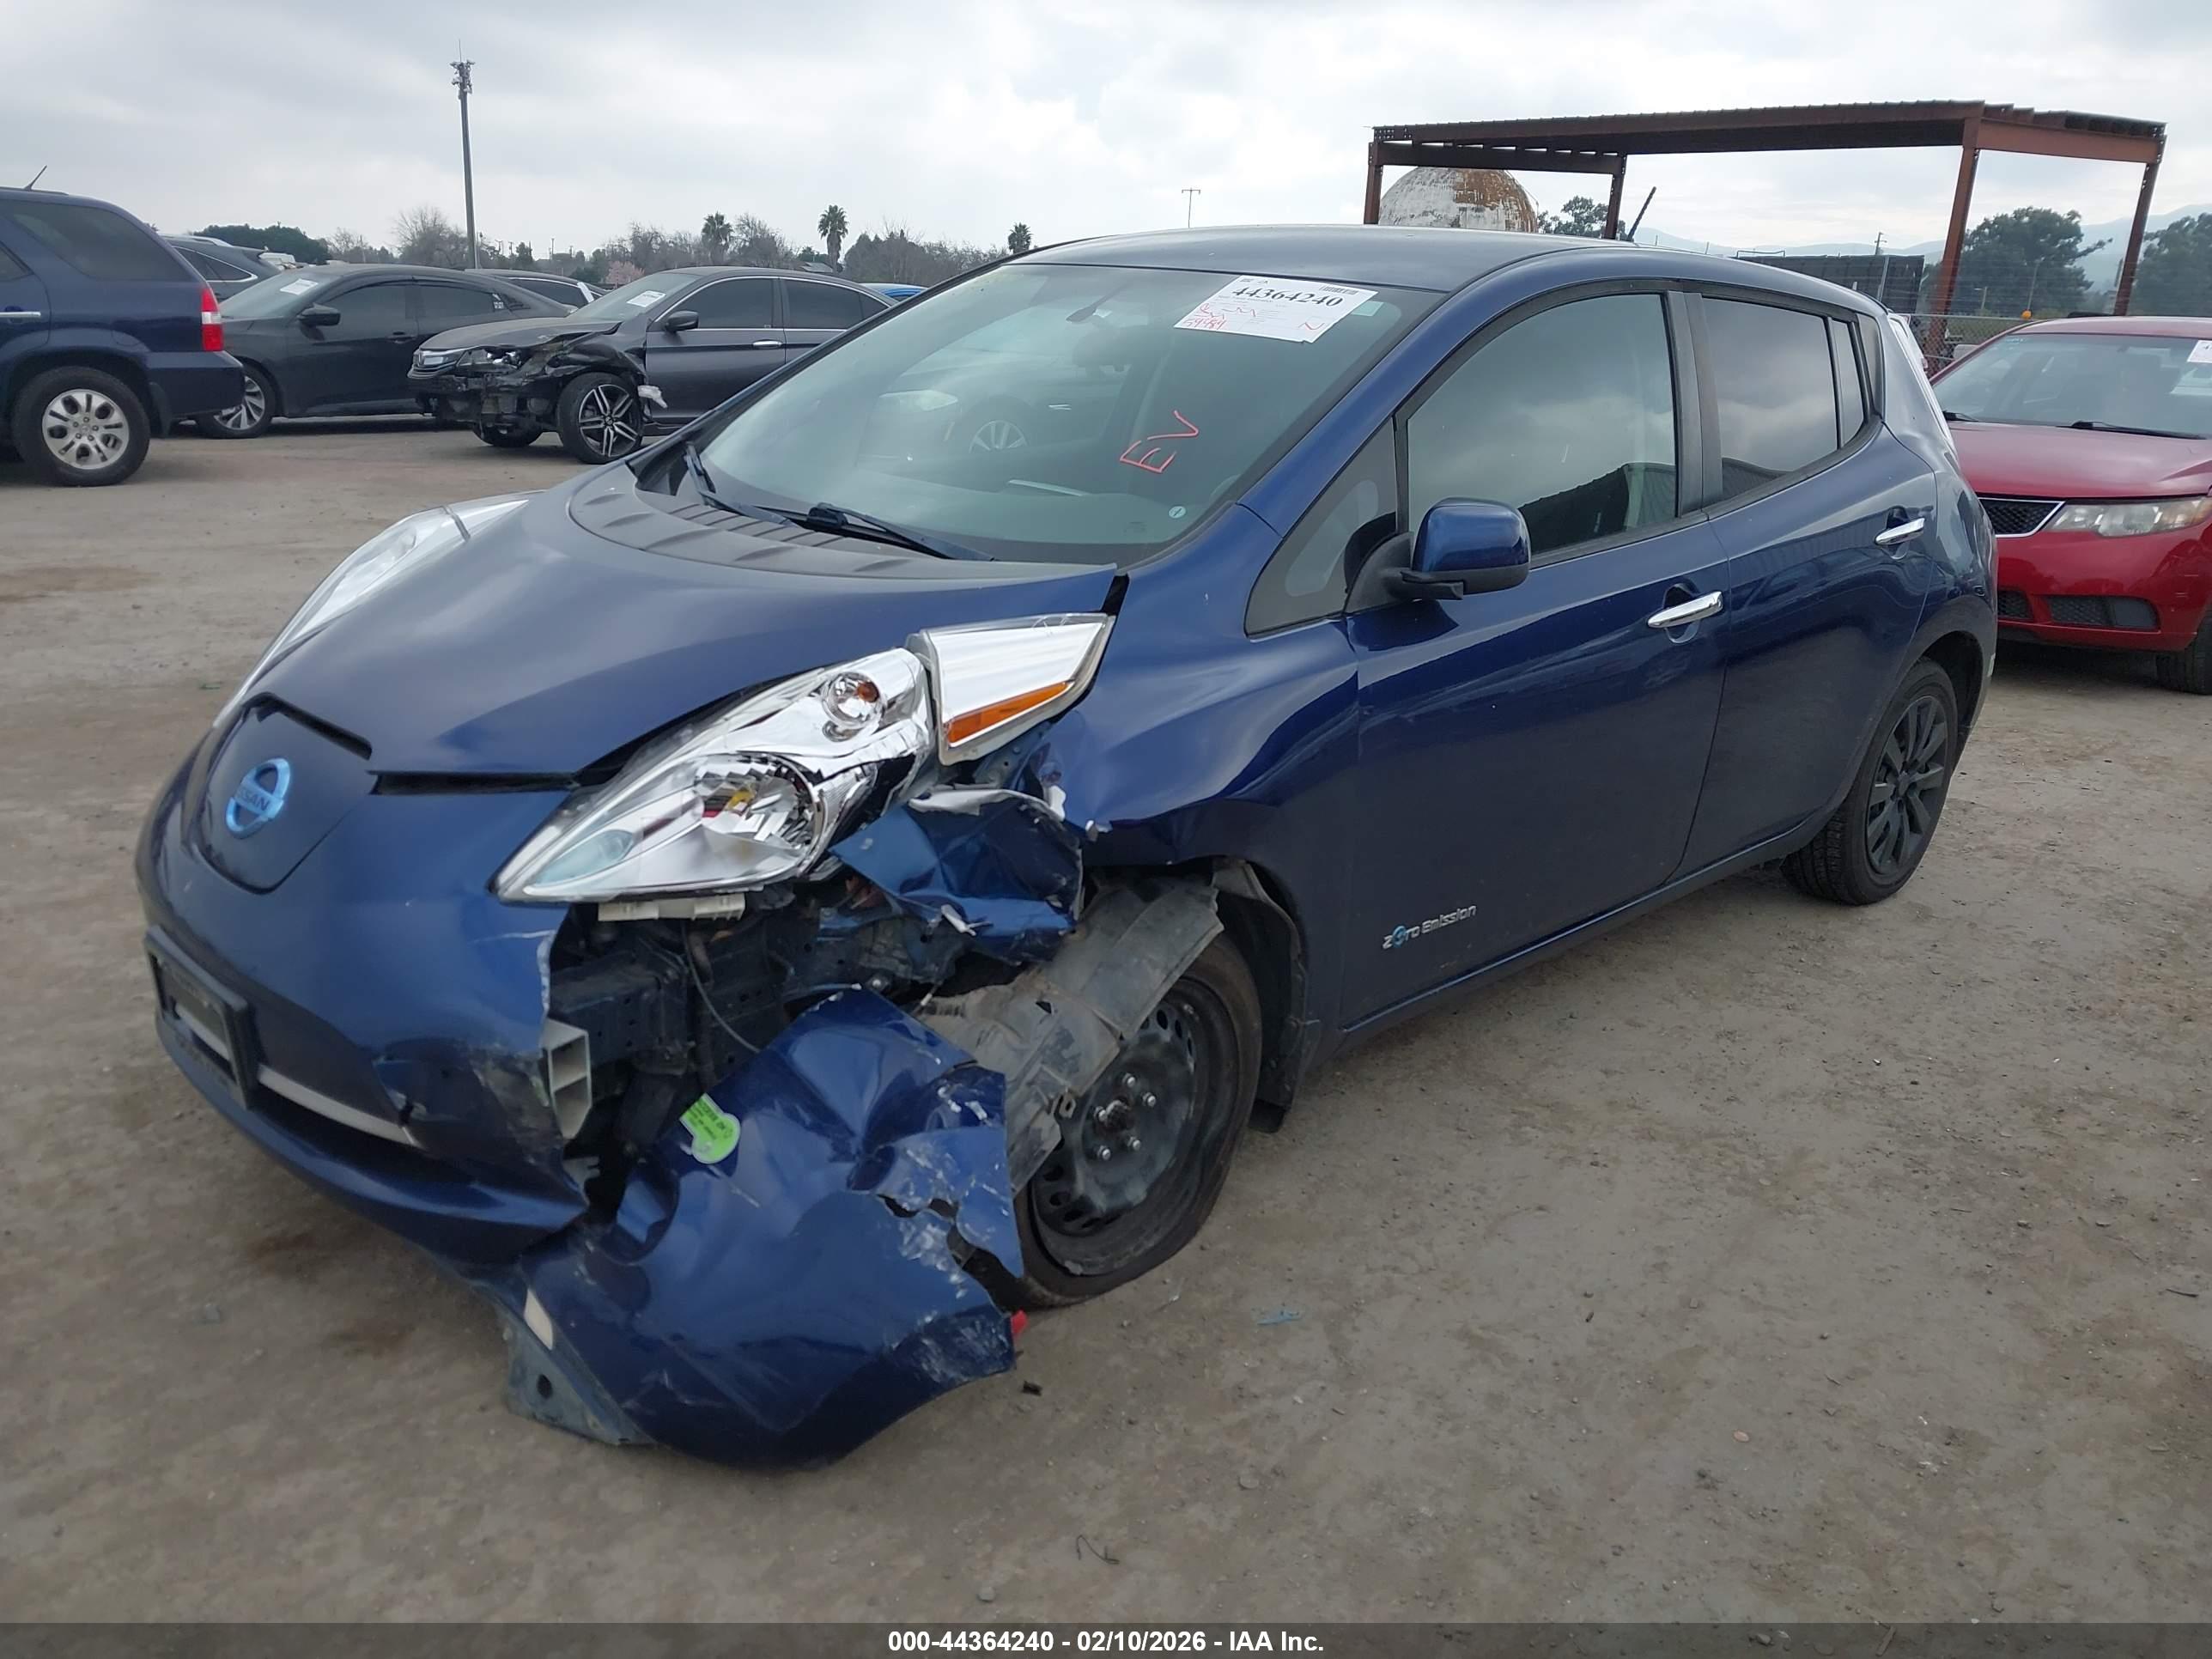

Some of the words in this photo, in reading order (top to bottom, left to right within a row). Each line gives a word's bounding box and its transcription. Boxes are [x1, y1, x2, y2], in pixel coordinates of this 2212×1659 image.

[1231, 287, 1344, 307] 44364240
[1119, 410, 1200, 473] EV
[1421, 905, 1477, 933] Emission
